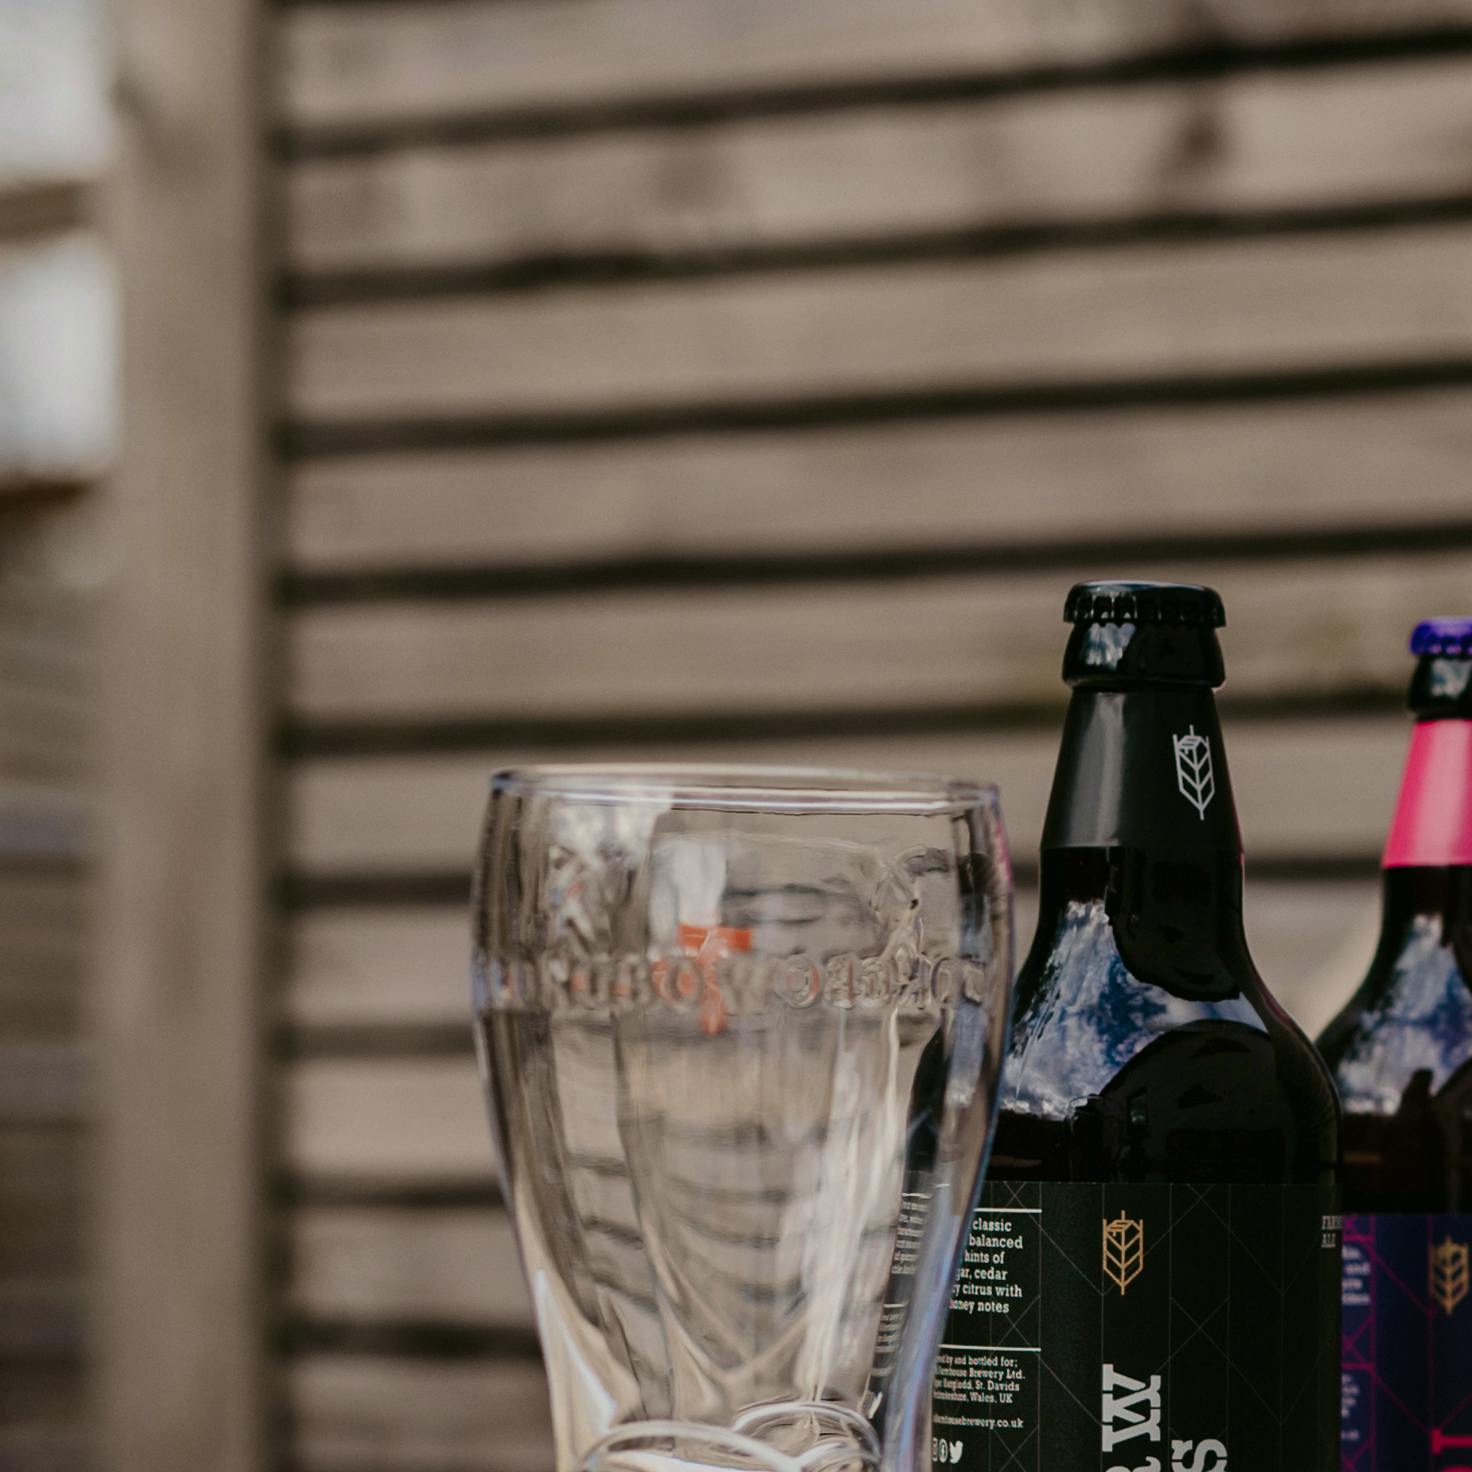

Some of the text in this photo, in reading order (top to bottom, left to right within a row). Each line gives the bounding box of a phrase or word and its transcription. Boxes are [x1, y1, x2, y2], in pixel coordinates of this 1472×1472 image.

[972, 1218, 1012, 1232] classic
[969, 1233, 1024, 1249] balanced
[964, 1249, 1006, 1264] hints of
[974, 1266, 1008, 1280] cedar
[962, 1282, 992, 1296] citrus
[995, 1284, 1023, 1298] with
[977, 1300, 1010, 1313] notes
[968, 1355, 998, 1366] bottled
[969, 1367, 1004, 1381] Brewery
[1006, 1369, 1026, 1380] Ltd.
[987, 1381, 1020, 1391] Davids
[999, 1393, 1013, 1404] UK
